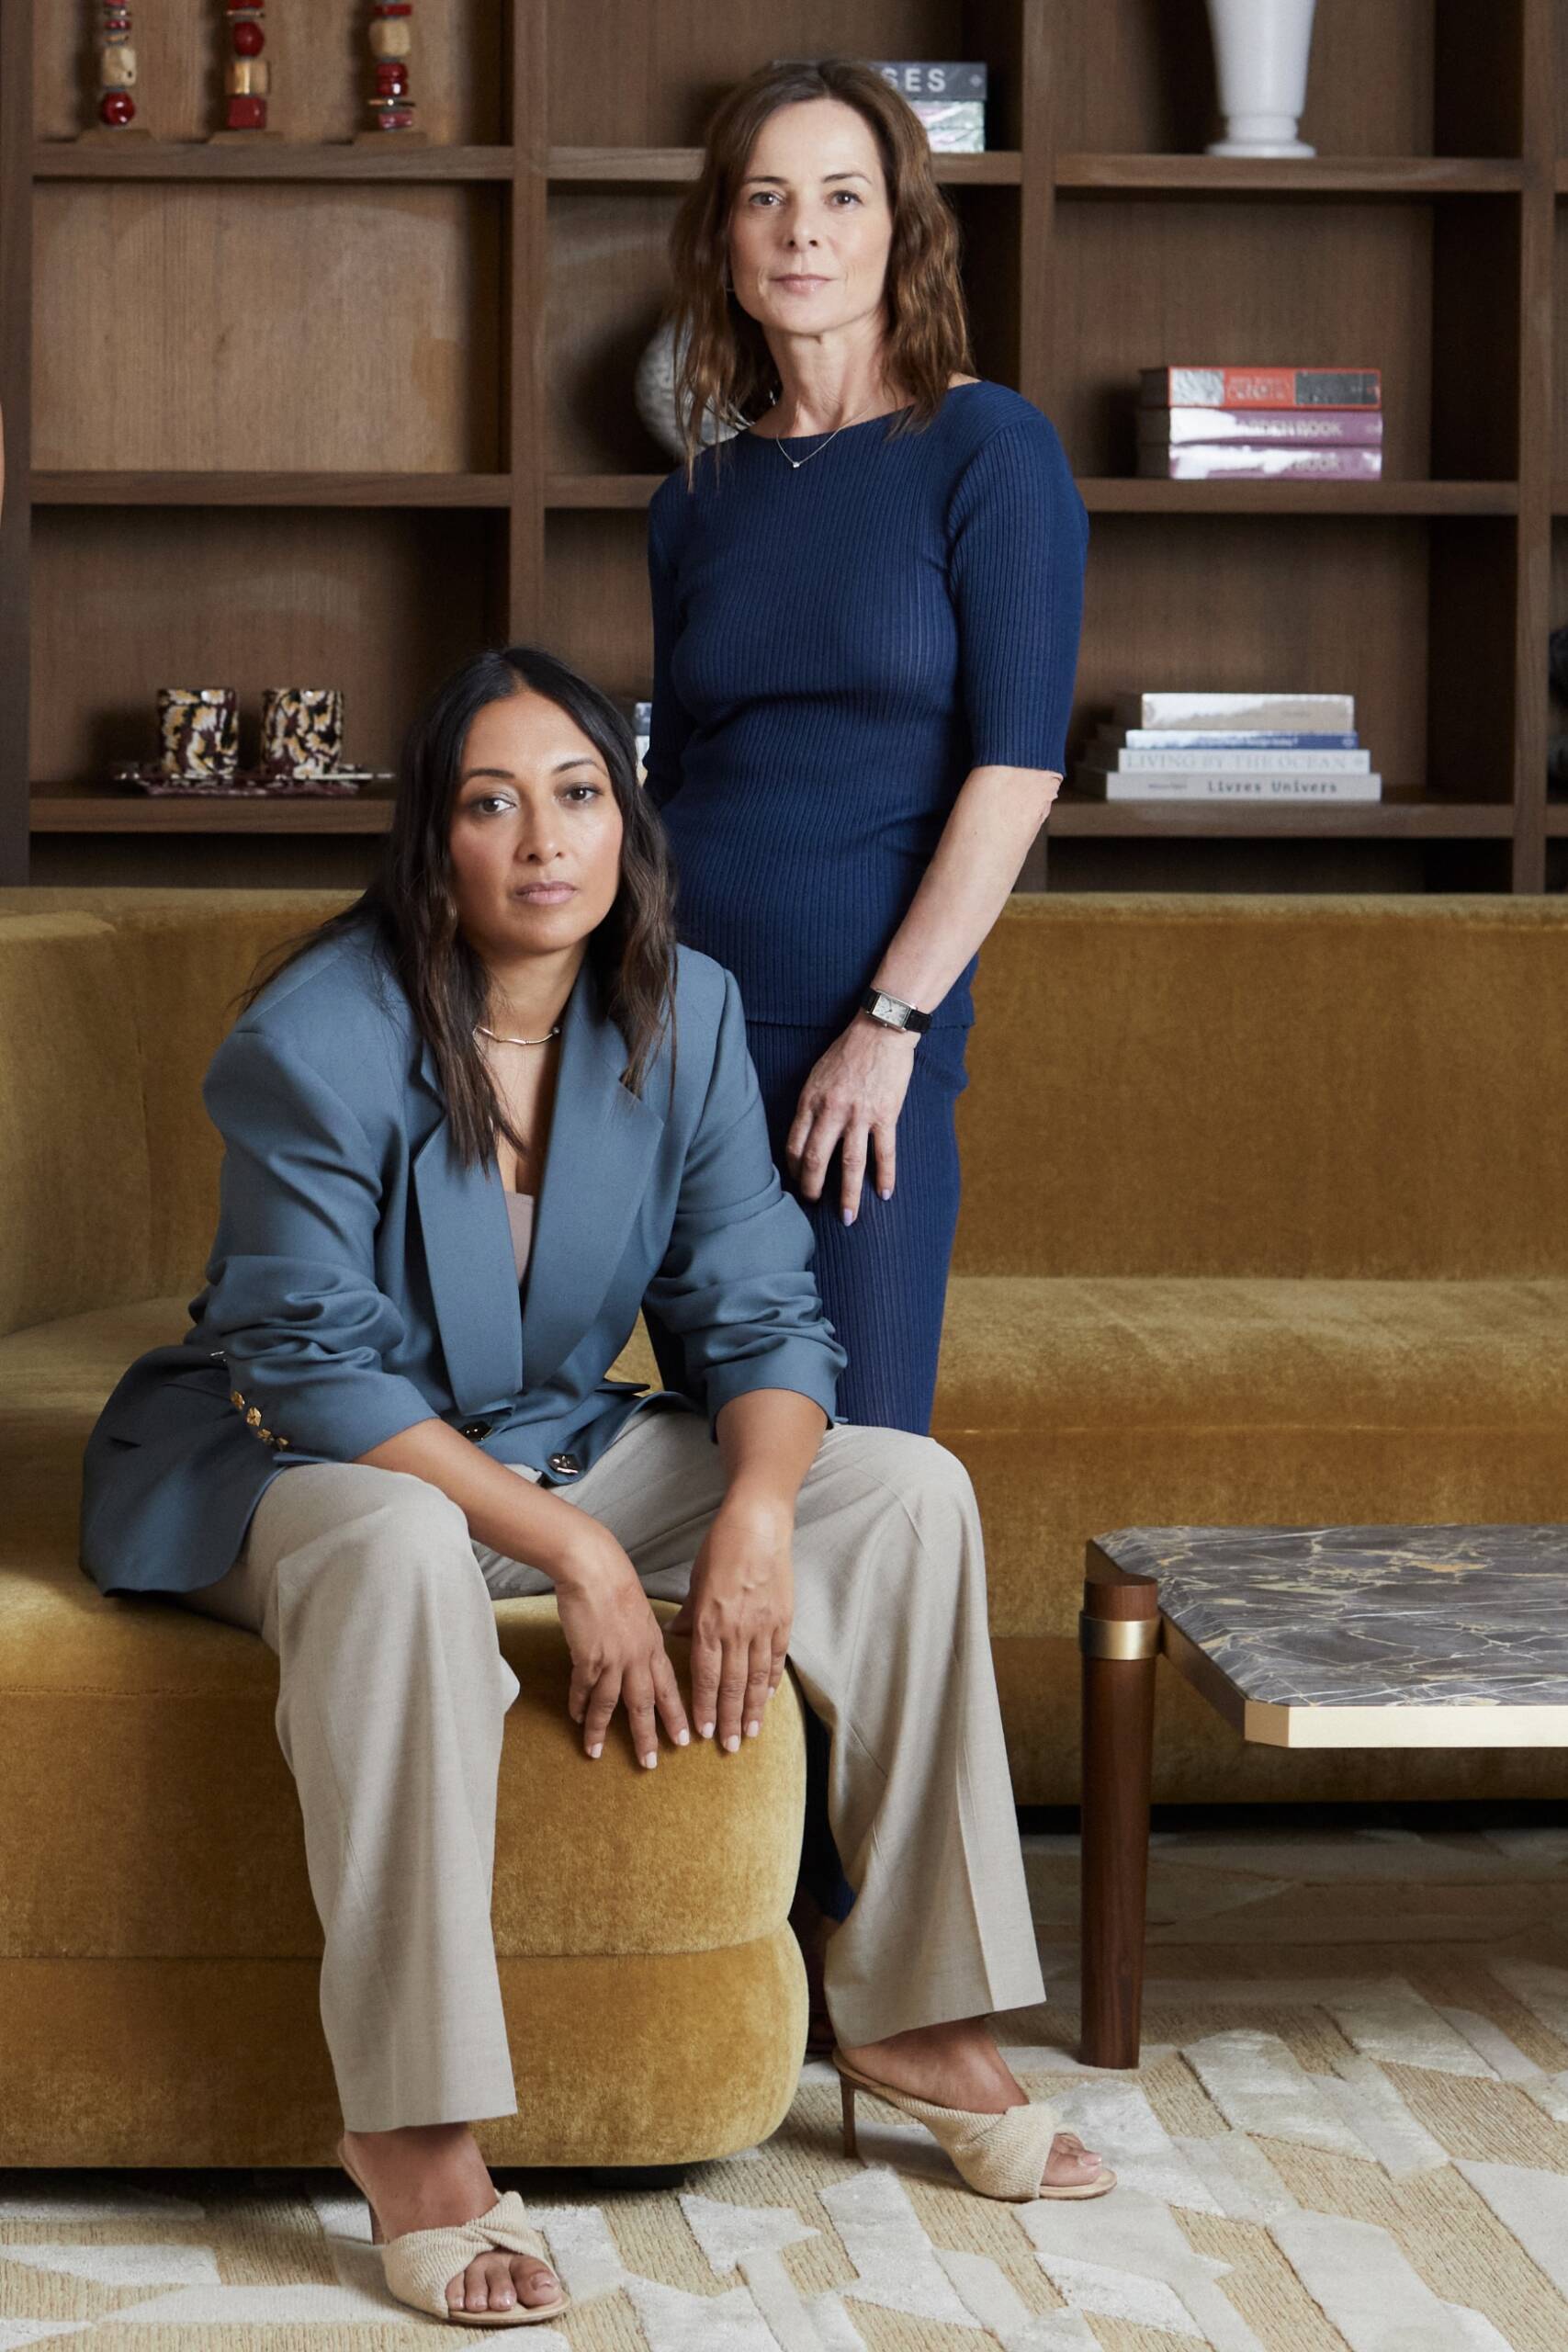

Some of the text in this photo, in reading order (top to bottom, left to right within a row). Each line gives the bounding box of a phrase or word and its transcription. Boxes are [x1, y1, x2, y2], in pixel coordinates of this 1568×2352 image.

[1126, 753, 1348, 769] LIVING BY THE OCEAN
[1207, 780, 1337, 793] Livres Univers
